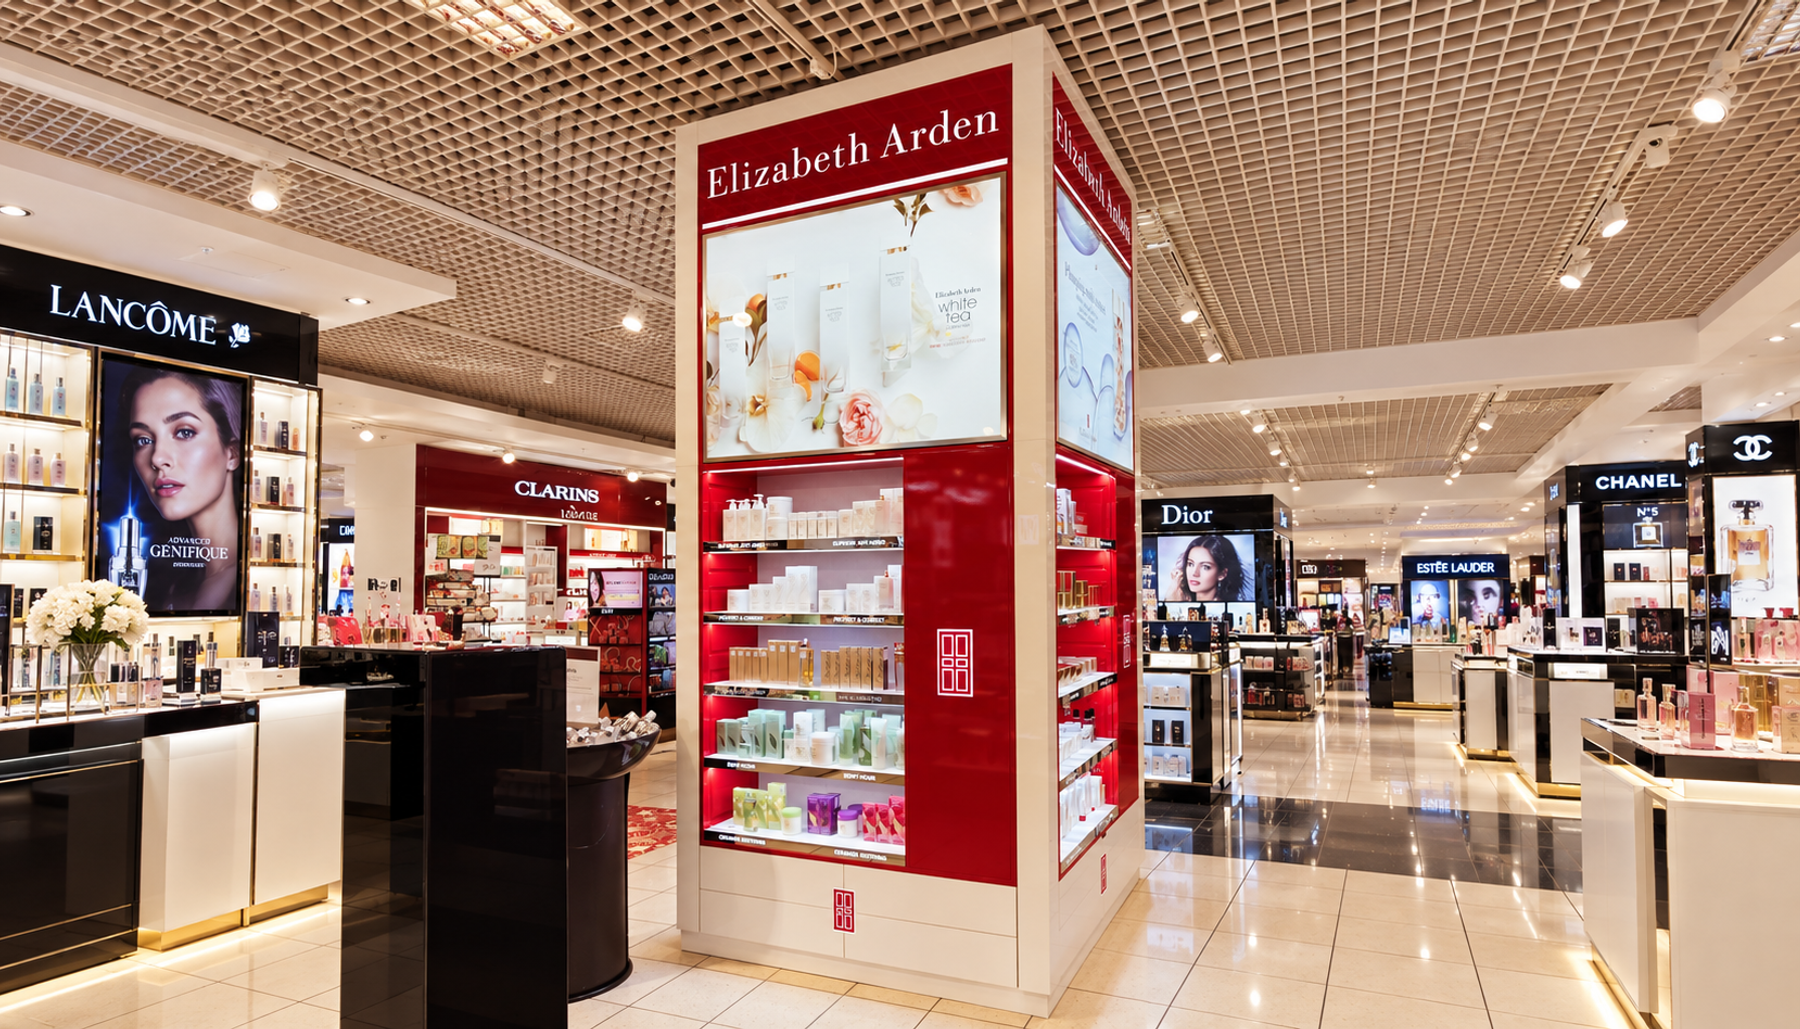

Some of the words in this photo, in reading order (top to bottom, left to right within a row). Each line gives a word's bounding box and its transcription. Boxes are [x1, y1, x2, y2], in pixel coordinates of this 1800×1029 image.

[706, 132, 870, 200] Elizabeth
[880, 109, 1000, 159] Arden
[937, 297, 978, 313] white
[49, 284, 217, 346] LANCÔME
[945, 311, 971, 324] tea
[1595, 473, 1683, 490] CHANEL
[514, 480, 600, 504] CLARINS
[1161, 504, 1214, 525] Dior
[167, 536, 211, 545] ADVANCED
[1451, 562, 1495, 573] LAUDER
